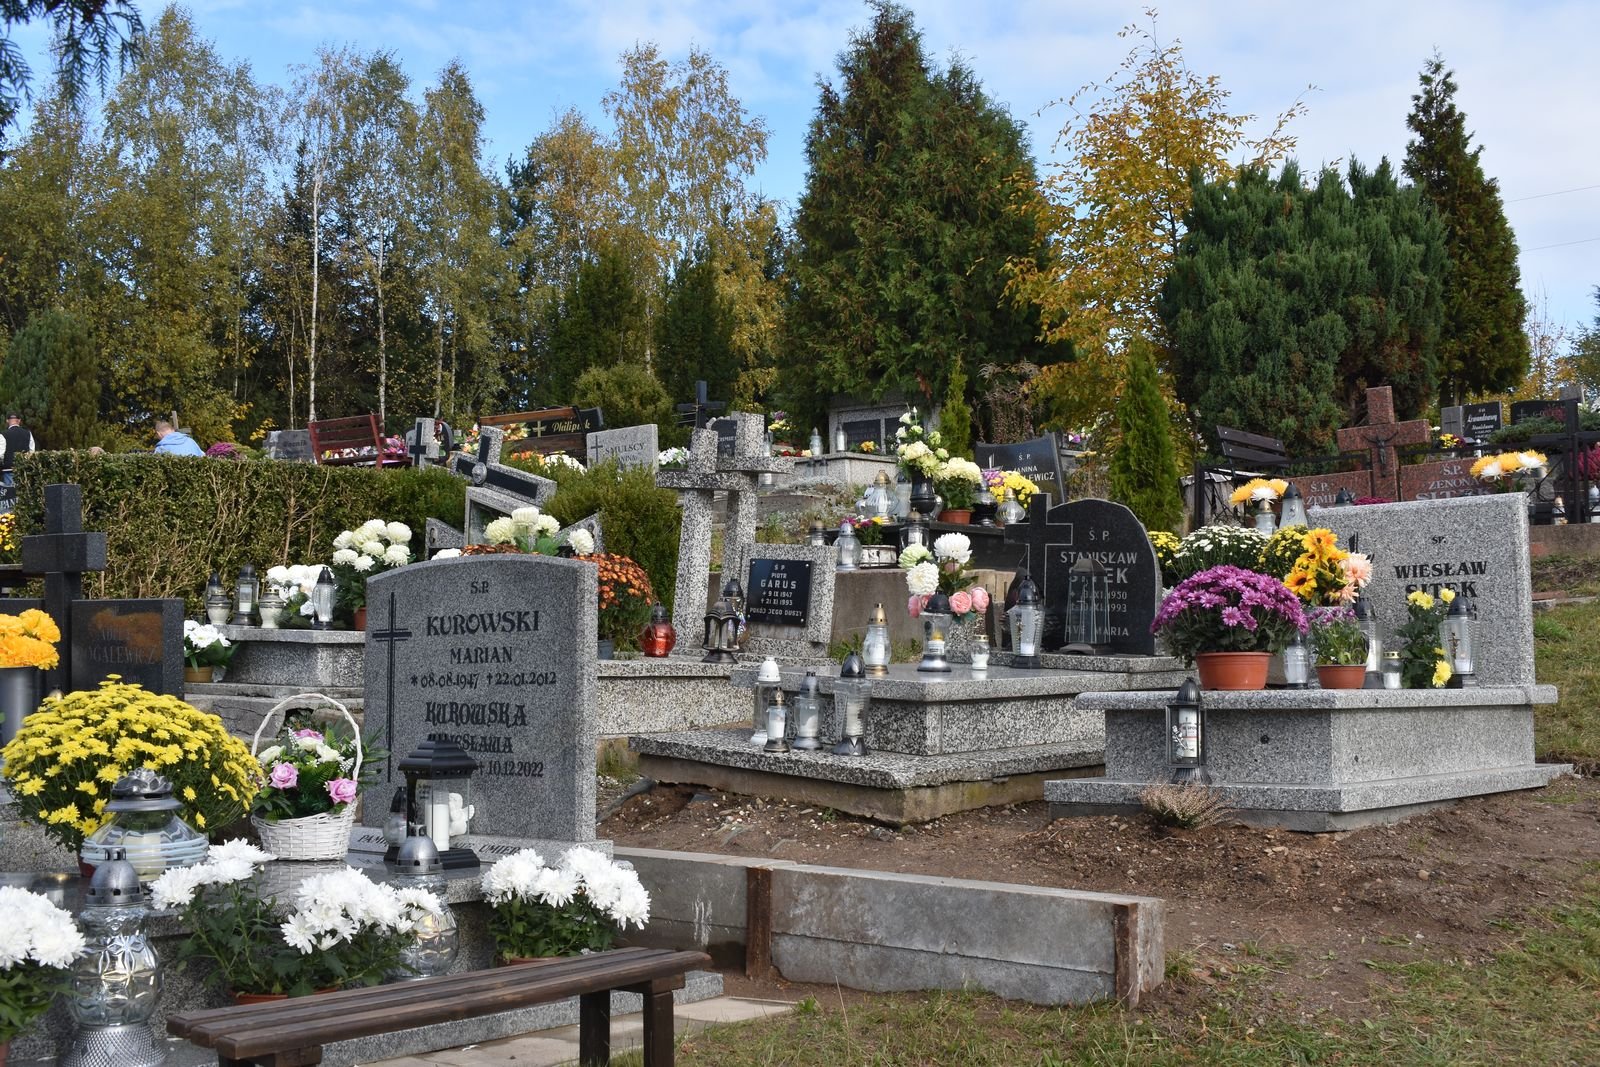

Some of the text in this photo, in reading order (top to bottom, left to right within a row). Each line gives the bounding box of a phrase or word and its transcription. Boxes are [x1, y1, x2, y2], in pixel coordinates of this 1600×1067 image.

[1393, 560, 1488, 579] WIESŁAW
[760, 579, 797, 590] GARUS
[426, 611, 540, 636] KUROWSKI
[450, 646, 513, 665] MARIAN
[425, 702, 528, 728] KUROWSKA
[479, 842, 522, 856] UMIER
